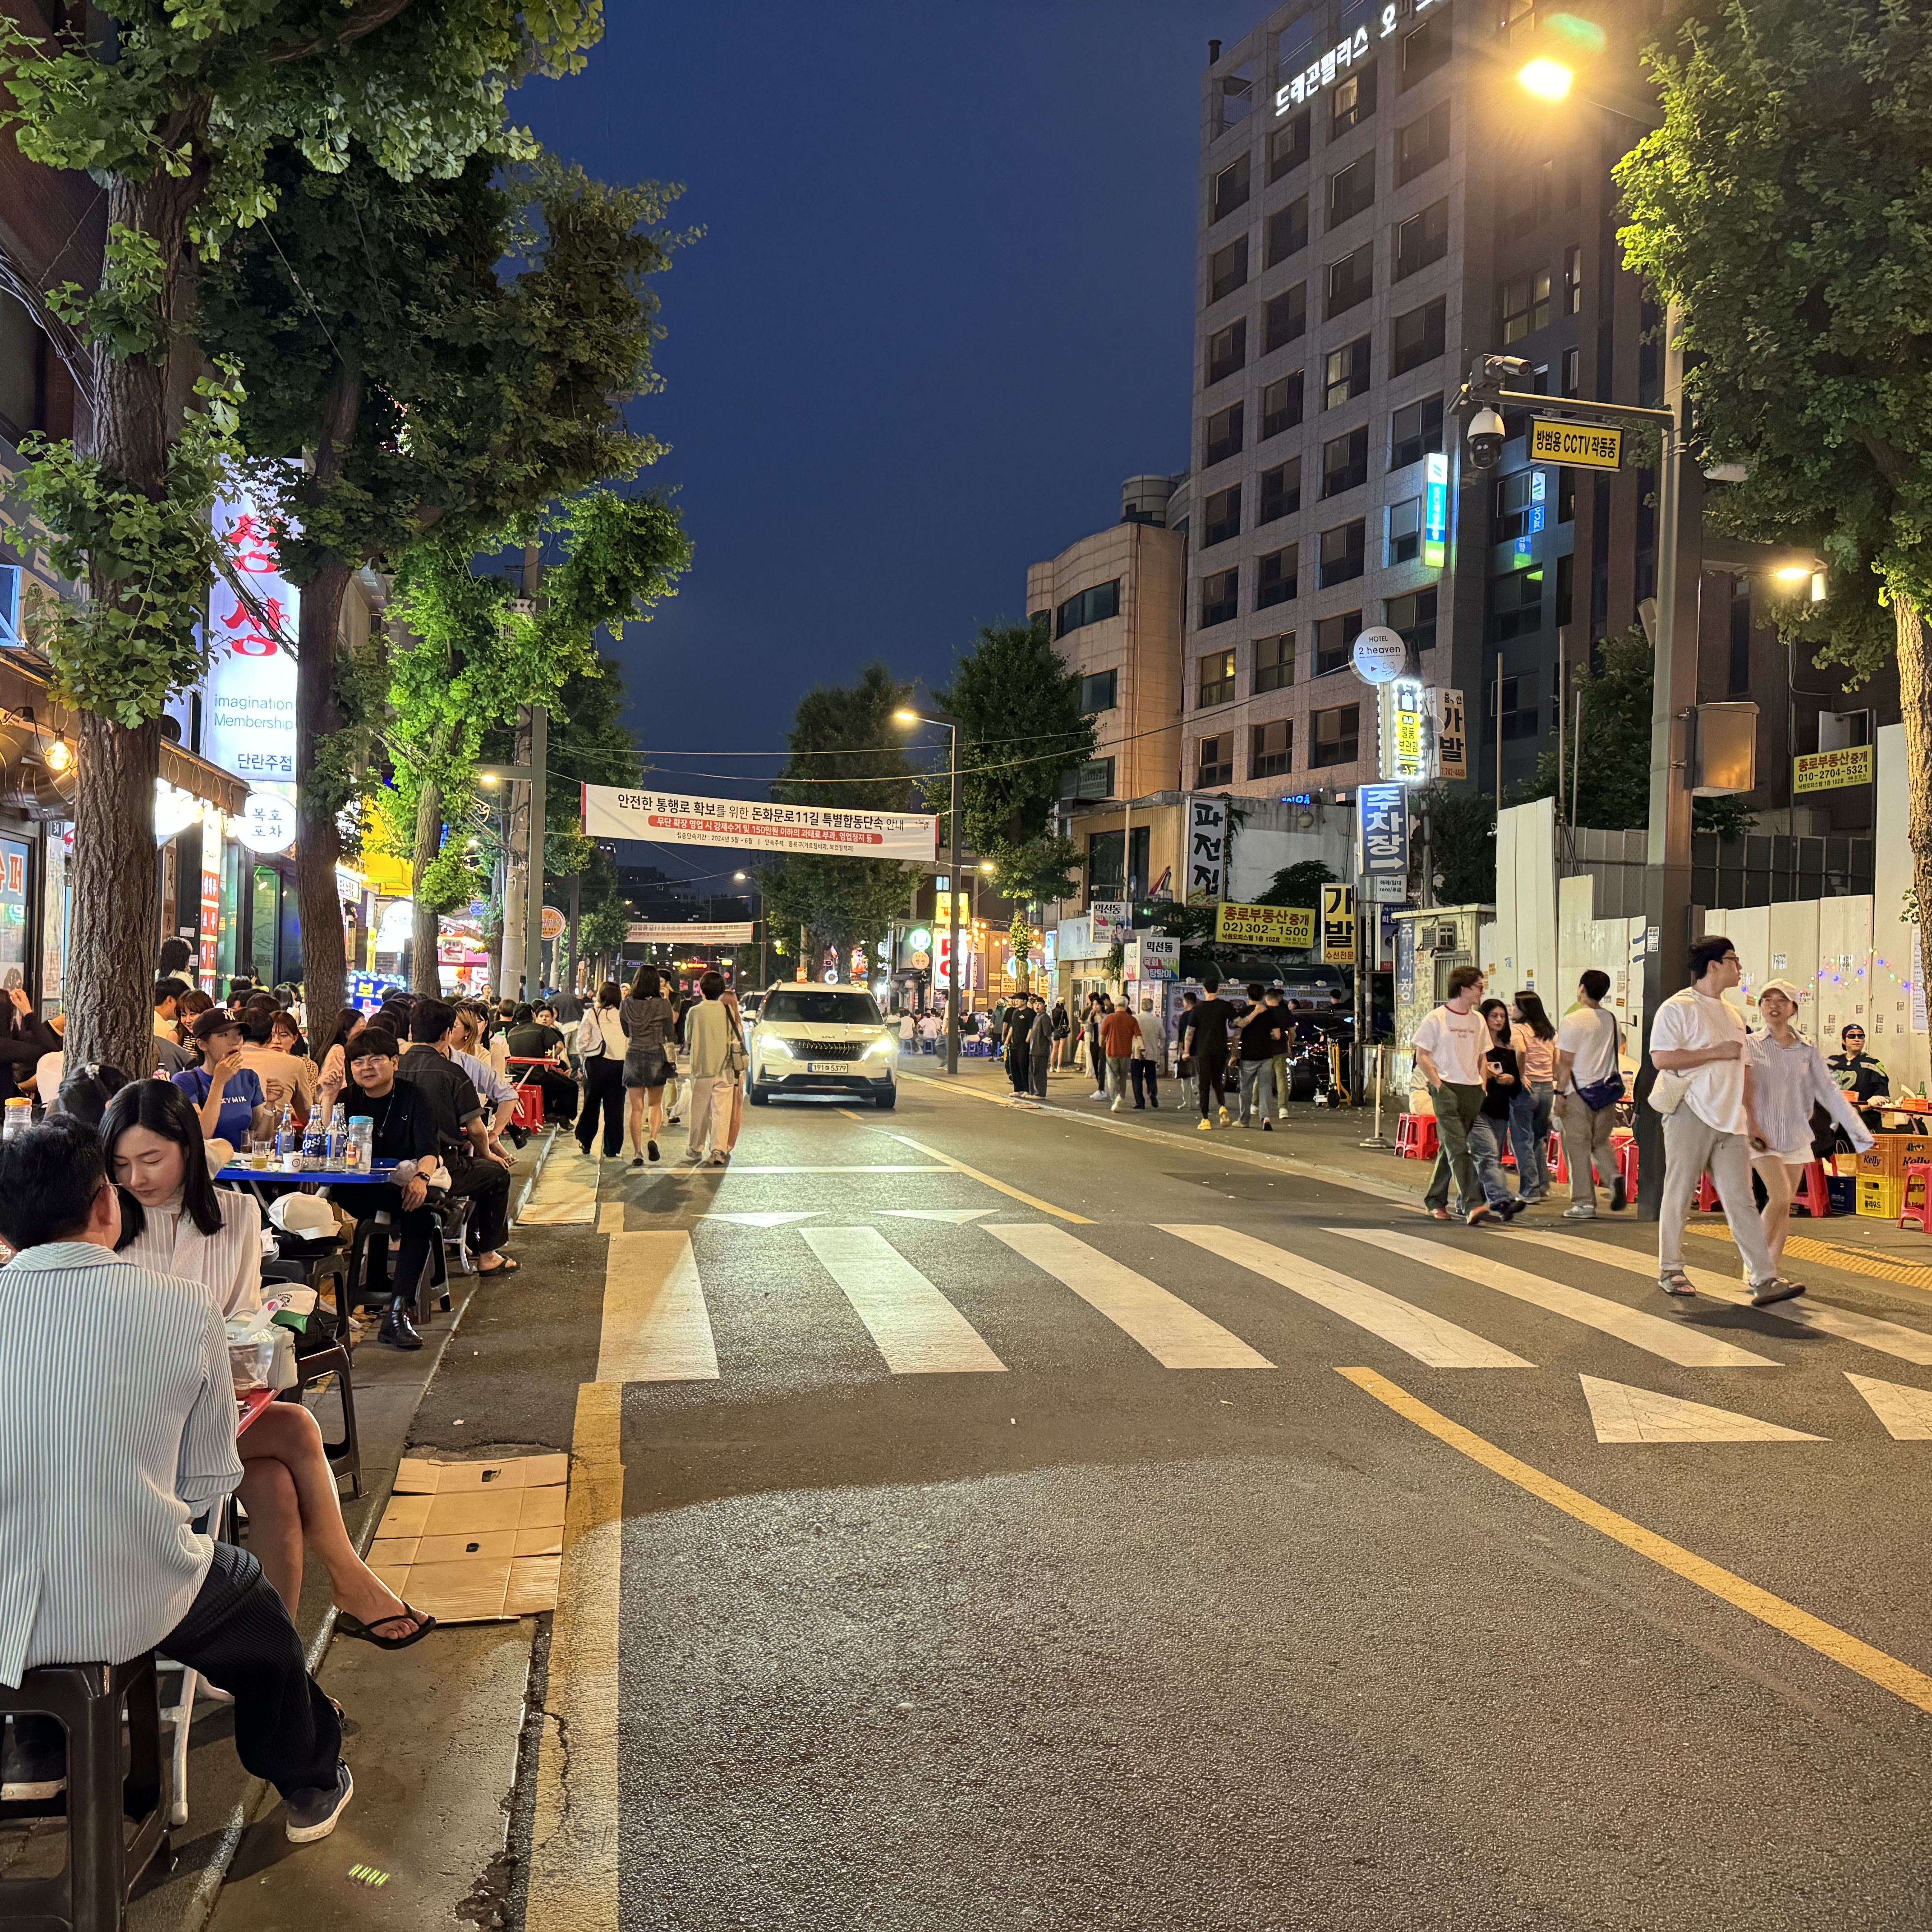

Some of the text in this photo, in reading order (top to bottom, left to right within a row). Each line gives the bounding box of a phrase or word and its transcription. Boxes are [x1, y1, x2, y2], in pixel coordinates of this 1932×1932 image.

[1537, 430, 1616, 458] 방범용 CCTV 작동중
[1367, 646, 1401, 654] heaven
[215, 694, 293, 710] imagination
[215, 713, 293, 731] Membership
[1440, 707, 1464, 763] 가발
[238, 754, 292, 771] 단란주점
[1799, 764, 1868, 782] 010-2704-5321
[618, 794, 904, 831] 안전한 통행로 확보를 위한 돈화문로11길 특별합동단속 안내
[252, 825, 283, 837] 포차
[657, 817, 873, 844] 무단 확장 영업 시 강제수거 및 150만원 이하의 과태료 부과, 영업정지 등
[1366, 790, 1404, 855] 주차장
[1193, 803, 1223, 895] 파전집
[1095, 904, 1121, 915] 익선동
[1325, 888, 1354, 948] 가발
[1223, 922, 1308, 936] 02)302-1500
[1146, 941, 1173, 953] 익선동
[1326, 951, 1354, 960] 수선전문
[1401, 924, 1414, 1001] 주차장
[1150, 969, 1172, 979] 탕탕이
[1863, 1155, 1881, 1167] Kelly
